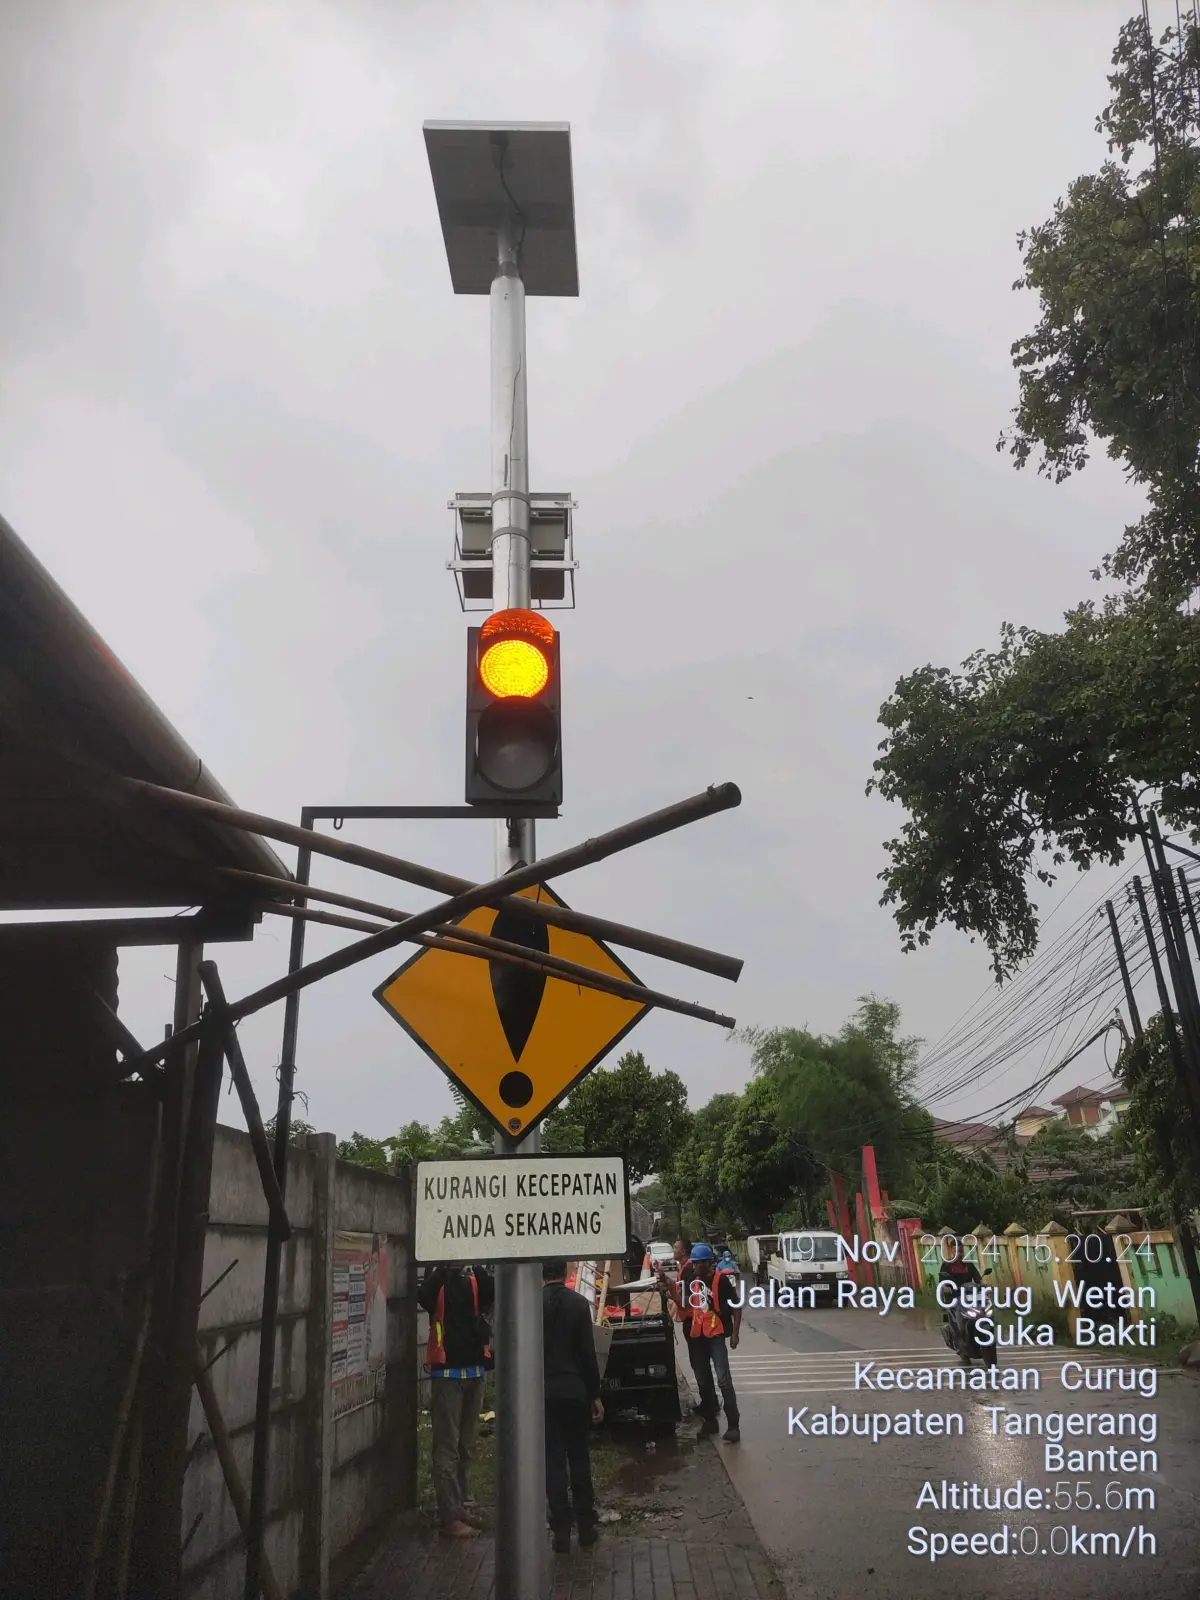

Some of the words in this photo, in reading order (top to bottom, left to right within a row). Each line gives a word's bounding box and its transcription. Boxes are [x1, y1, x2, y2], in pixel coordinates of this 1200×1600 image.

[424, 1174, 507, 1200] KURANGI
[516, 1173, 617, 1197] KECEPATAN
[443, 1213, 496, 1239] ANDA
[505, 1211, 602, 1237] SEKARANG
